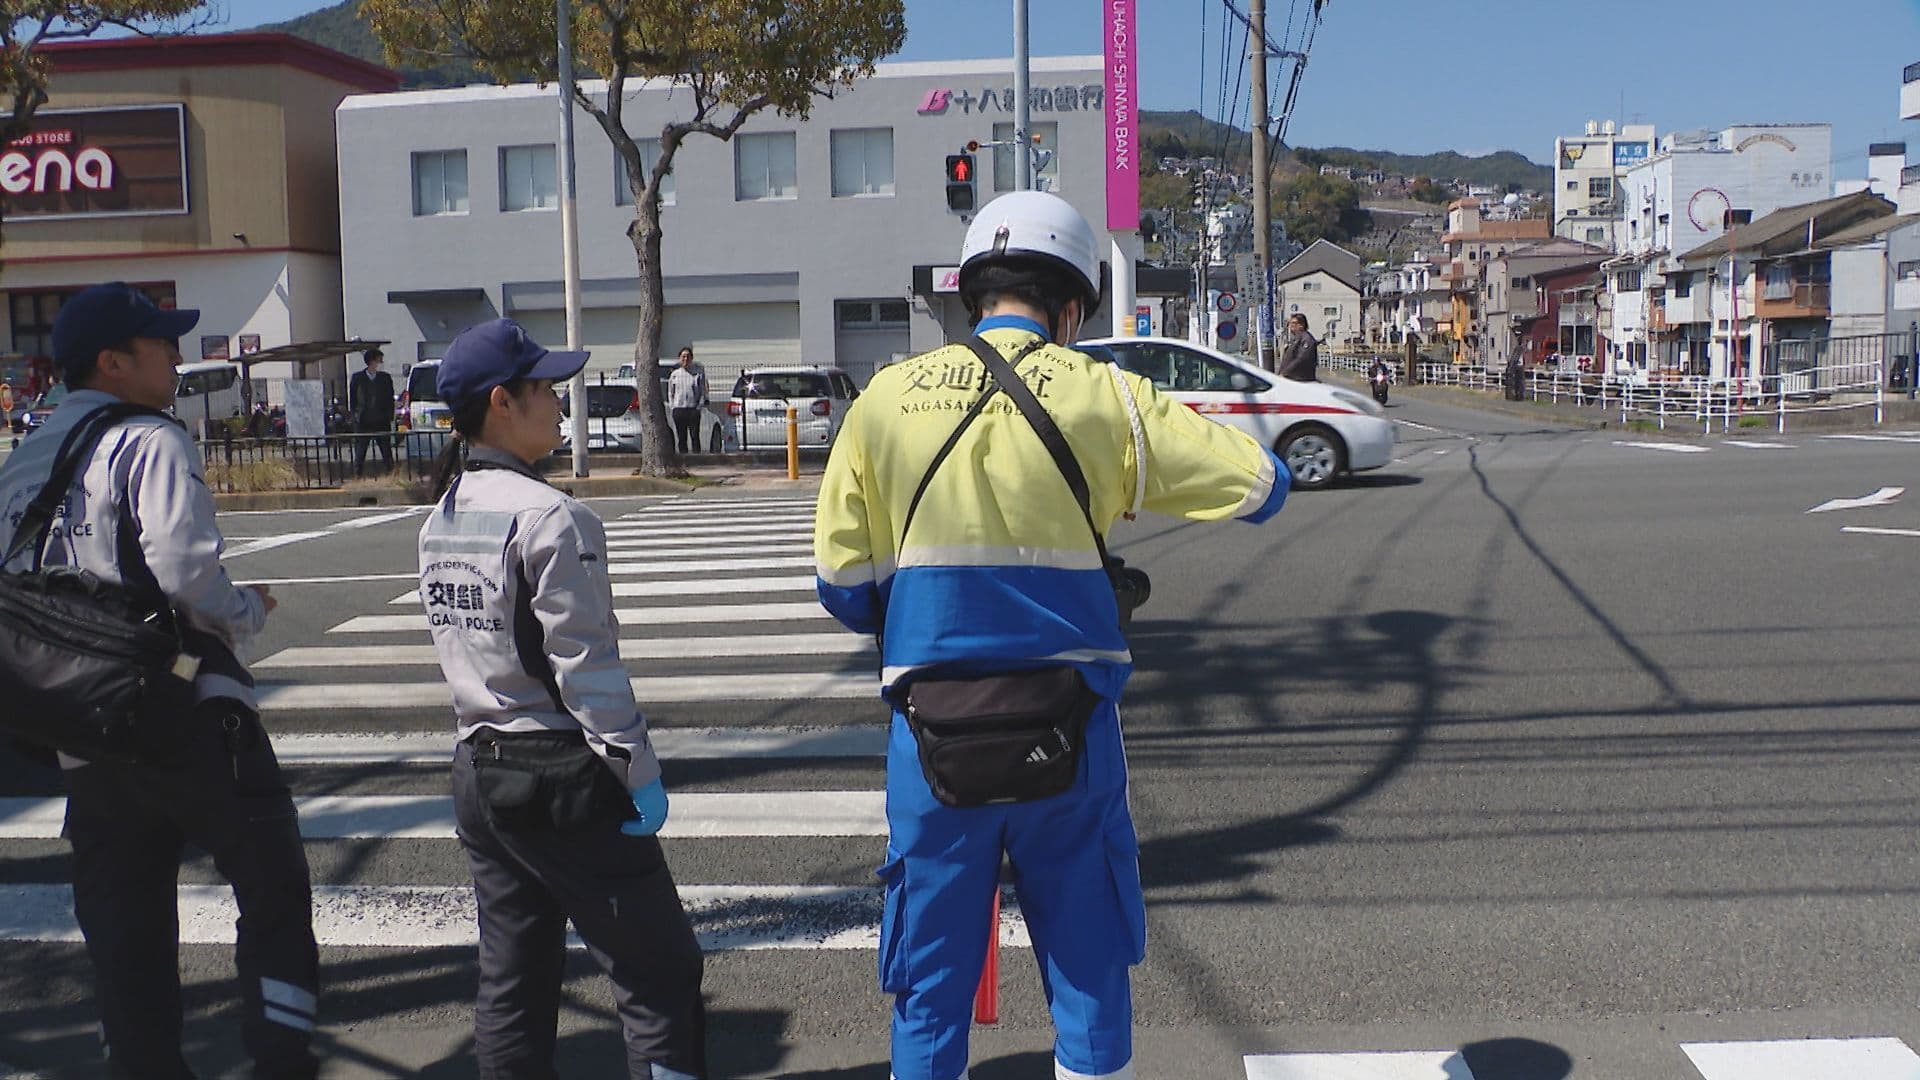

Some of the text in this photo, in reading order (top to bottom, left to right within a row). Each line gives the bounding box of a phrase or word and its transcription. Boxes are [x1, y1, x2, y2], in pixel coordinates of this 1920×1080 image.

[36, 132, 72, 144] STORE
[1115, 127, 1129, 170] BANK
[1138, 319, 1148, 332] P
